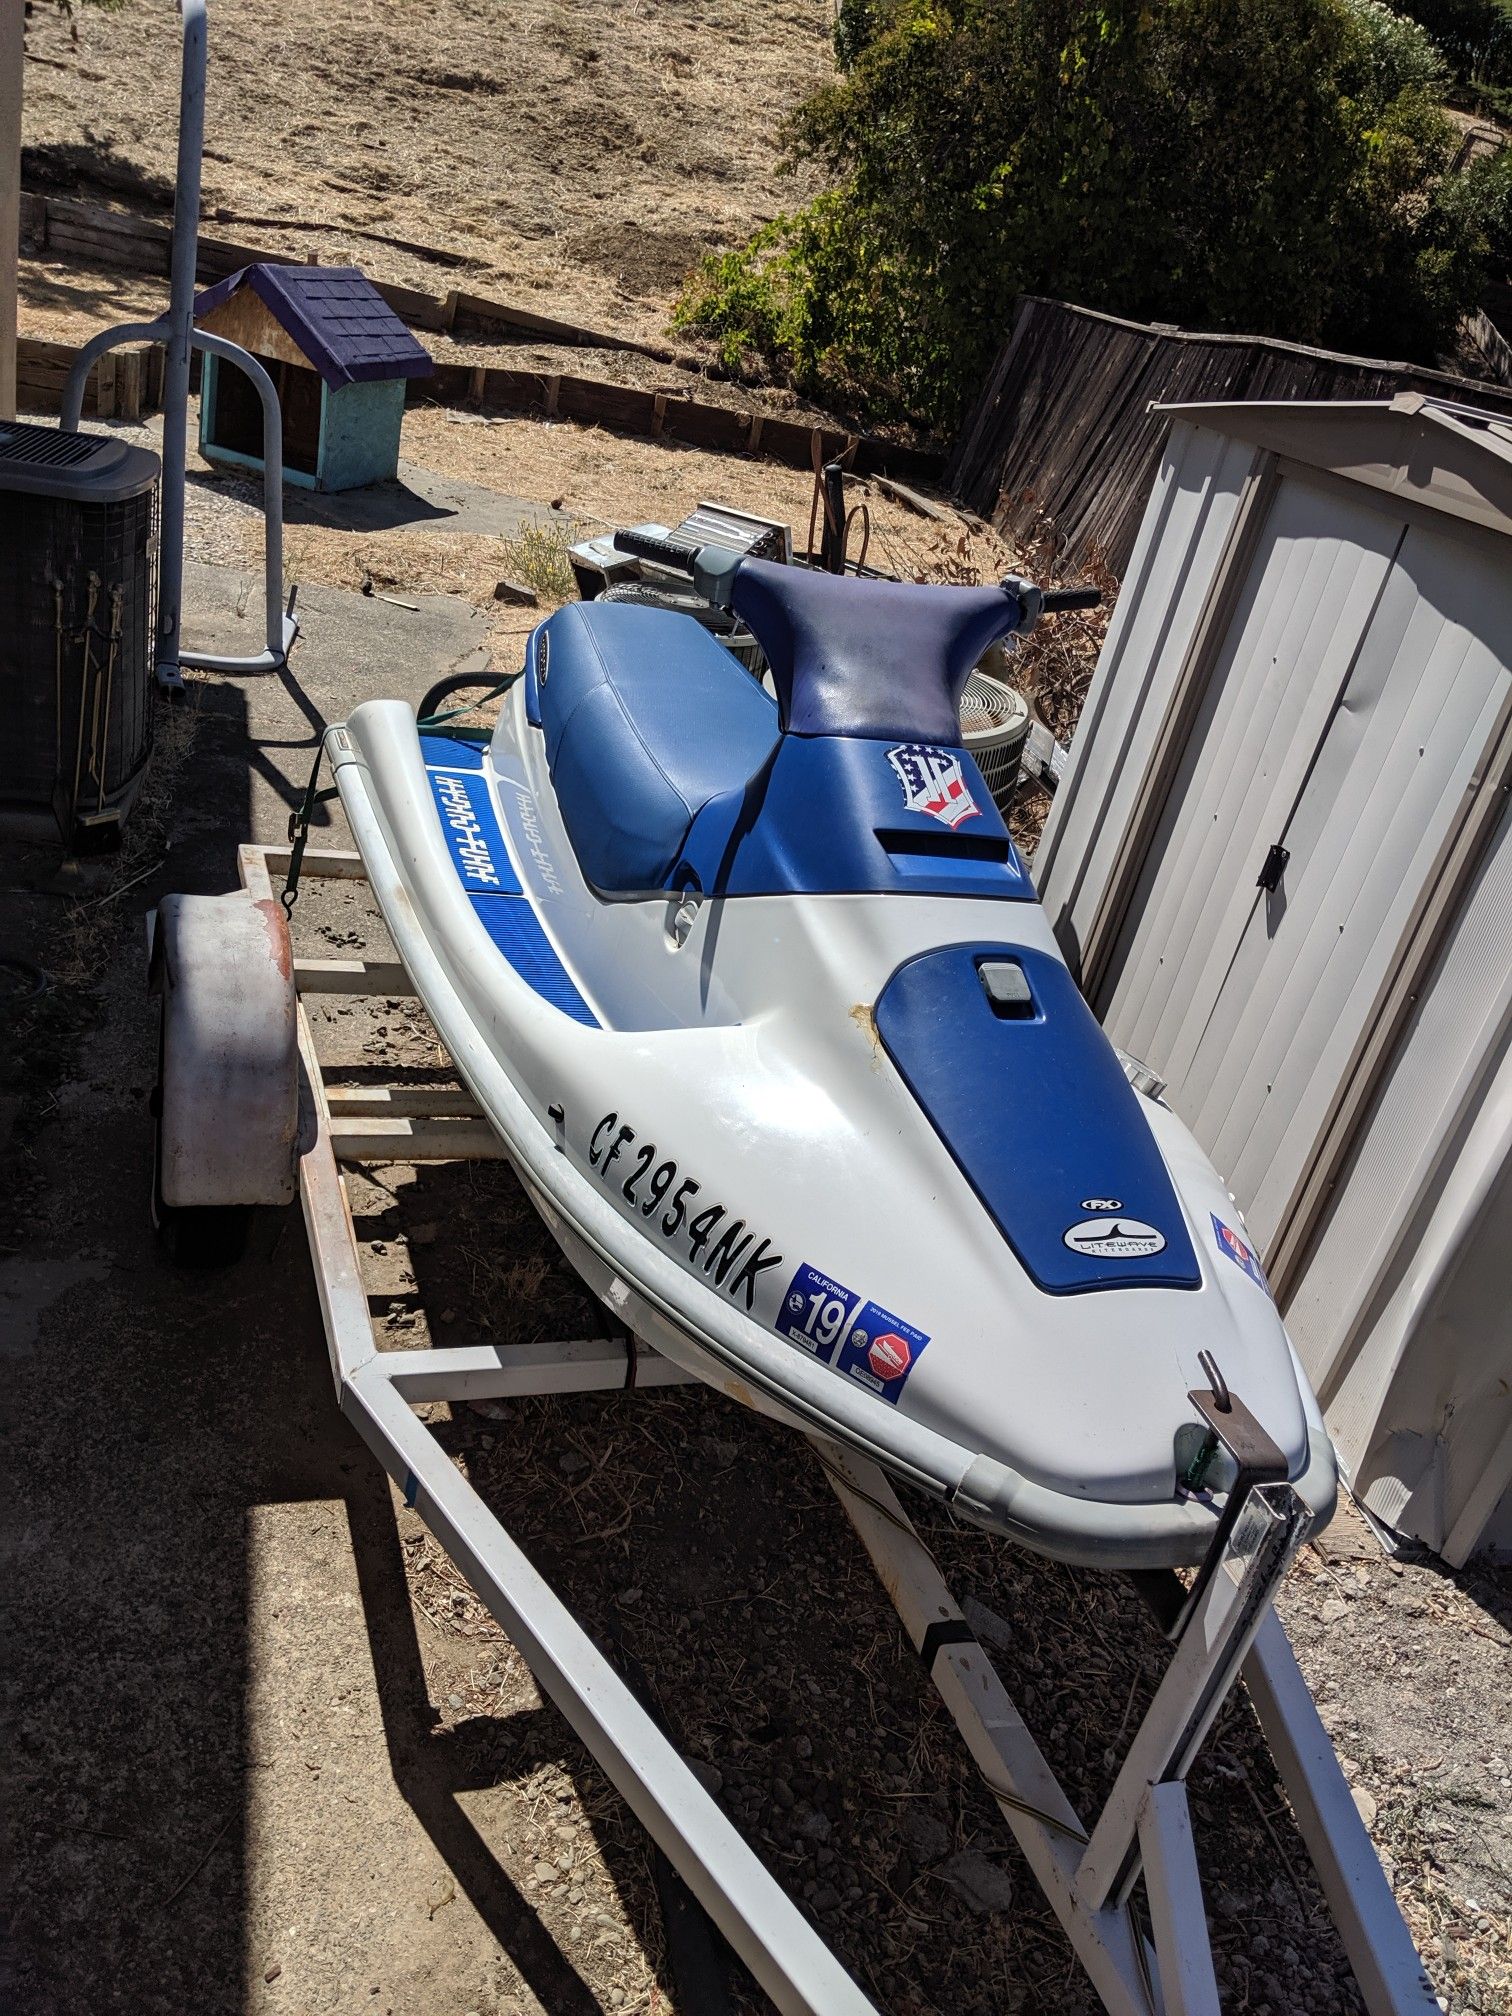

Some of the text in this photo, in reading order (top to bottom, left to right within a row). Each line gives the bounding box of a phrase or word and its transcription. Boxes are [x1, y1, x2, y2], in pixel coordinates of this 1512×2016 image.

[589, 1112, 635, 1177] CF
[1088, 1199, 1119, 1210] FX
[1080, 1241, 1158, 1250] LITEWAVE
[807, 1271, 849, 1301] CALIFORNIA
[803, 1292, 846, 1345] 19
[881, 1313, 900, 1328] MUSSEL
[900, 1324, 911, 1335] FEE
[909, 1331, 923, 1341] PAID
